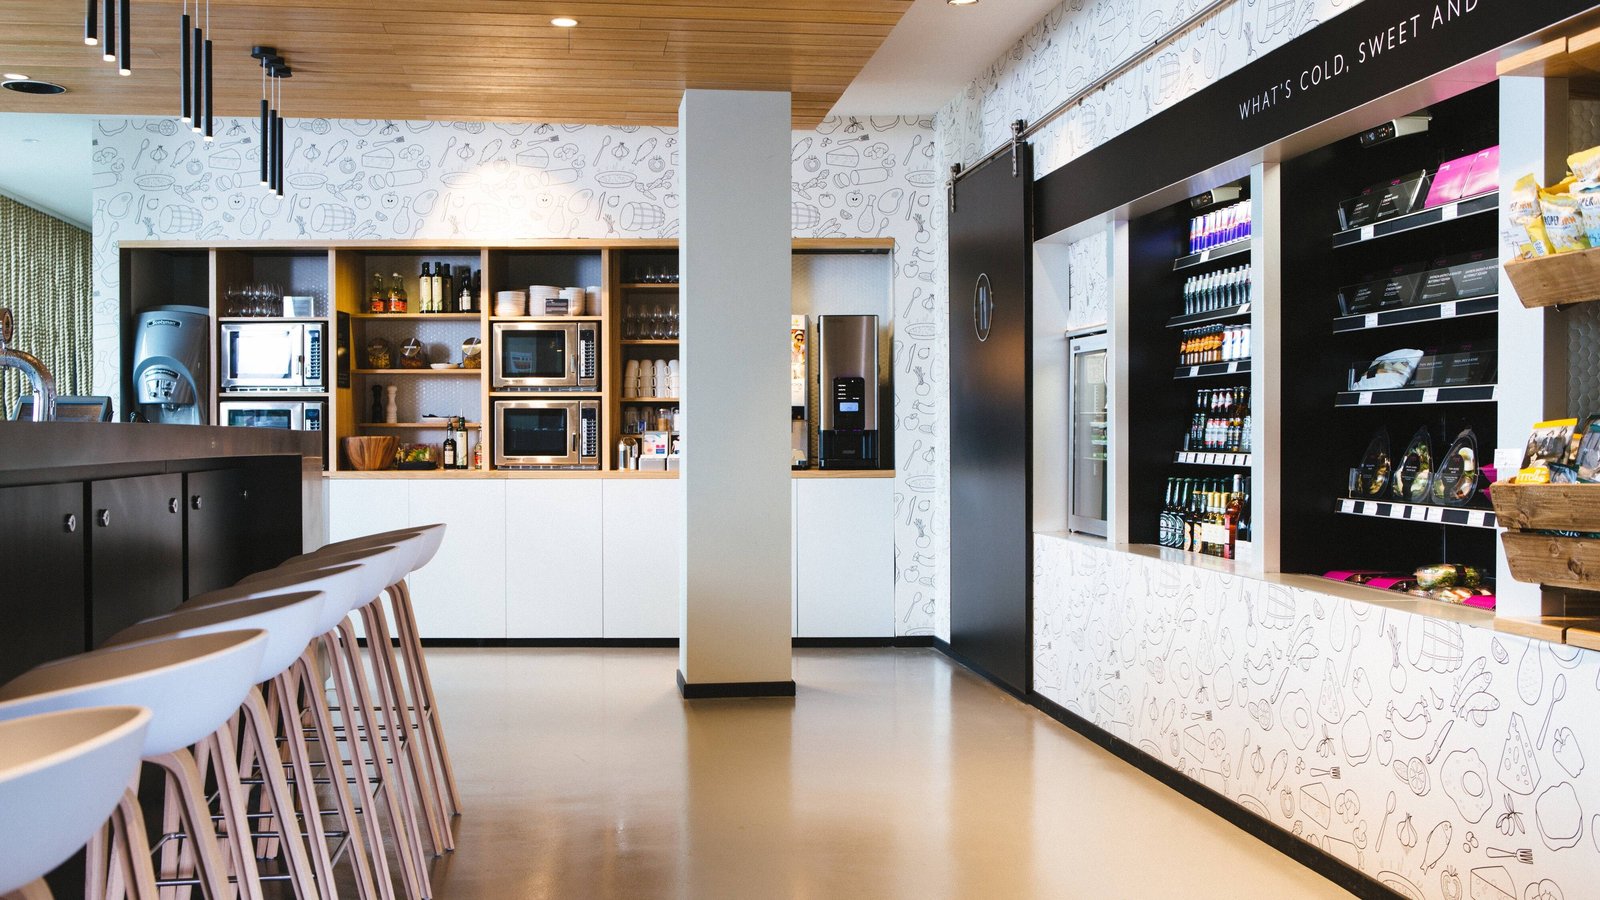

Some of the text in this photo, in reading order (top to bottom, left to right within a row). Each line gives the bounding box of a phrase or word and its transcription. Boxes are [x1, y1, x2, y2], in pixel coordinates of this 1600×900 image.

[1239, 0, 1478, 120] WHAT'S COLD, SWEET AND
